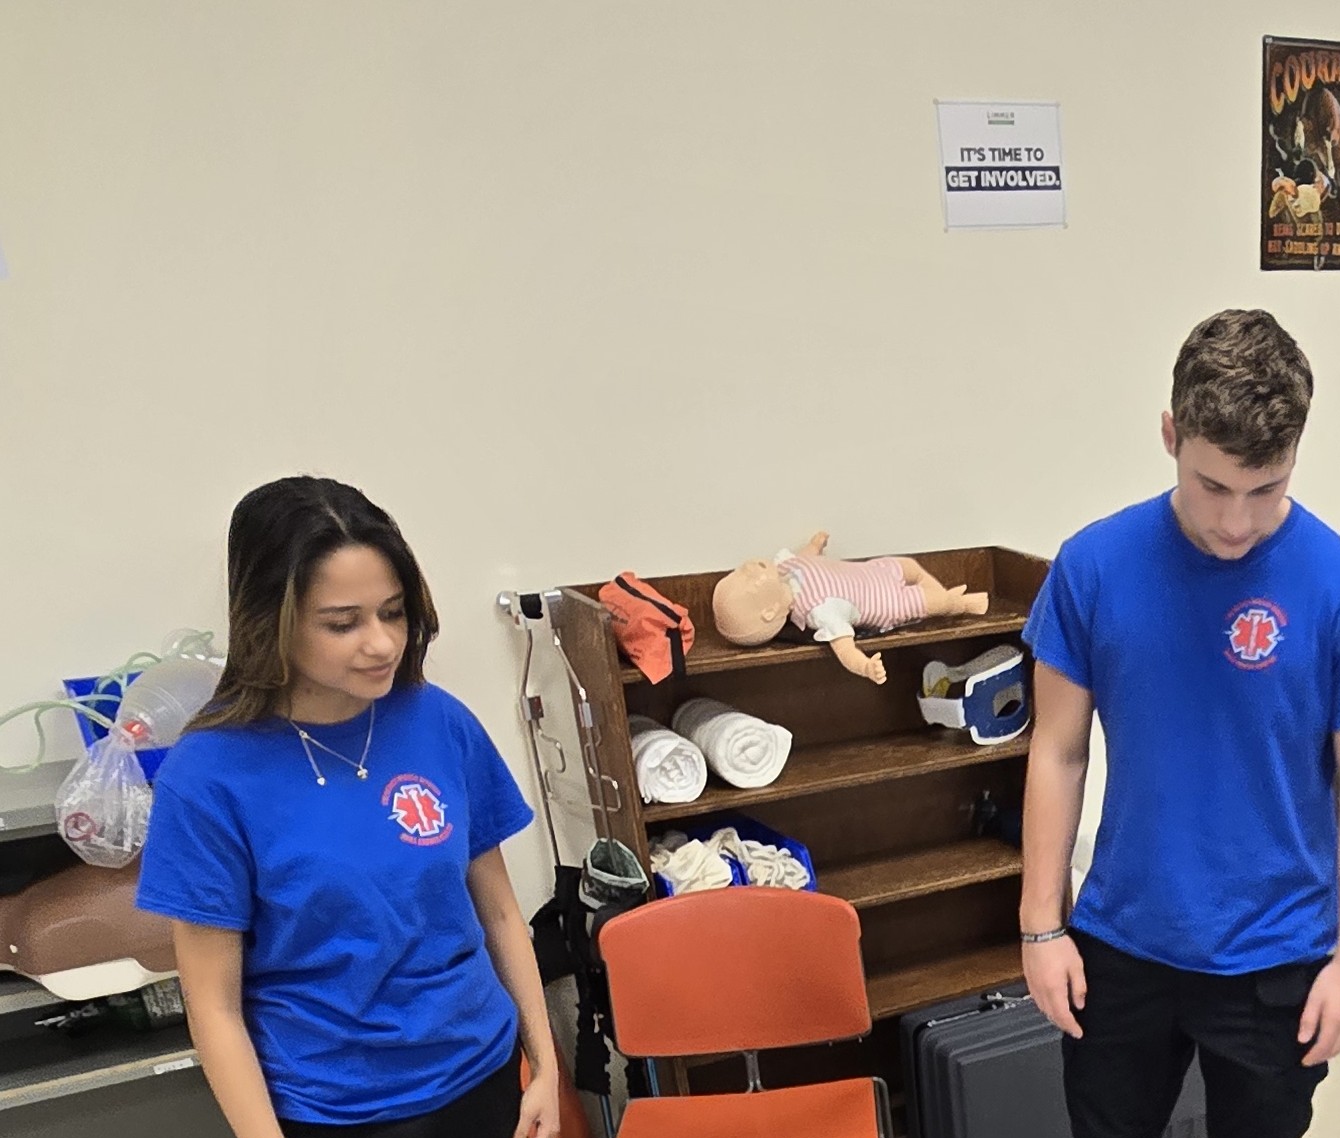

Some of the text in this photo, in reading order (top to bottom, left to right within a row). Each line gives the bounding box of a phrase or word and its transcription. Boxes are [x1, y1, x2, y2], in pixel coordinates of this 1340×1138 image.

[960, 146, 1045, 162] IT'S TIME TO
[947, 170, 1060, 187] GET INVOLVED.
